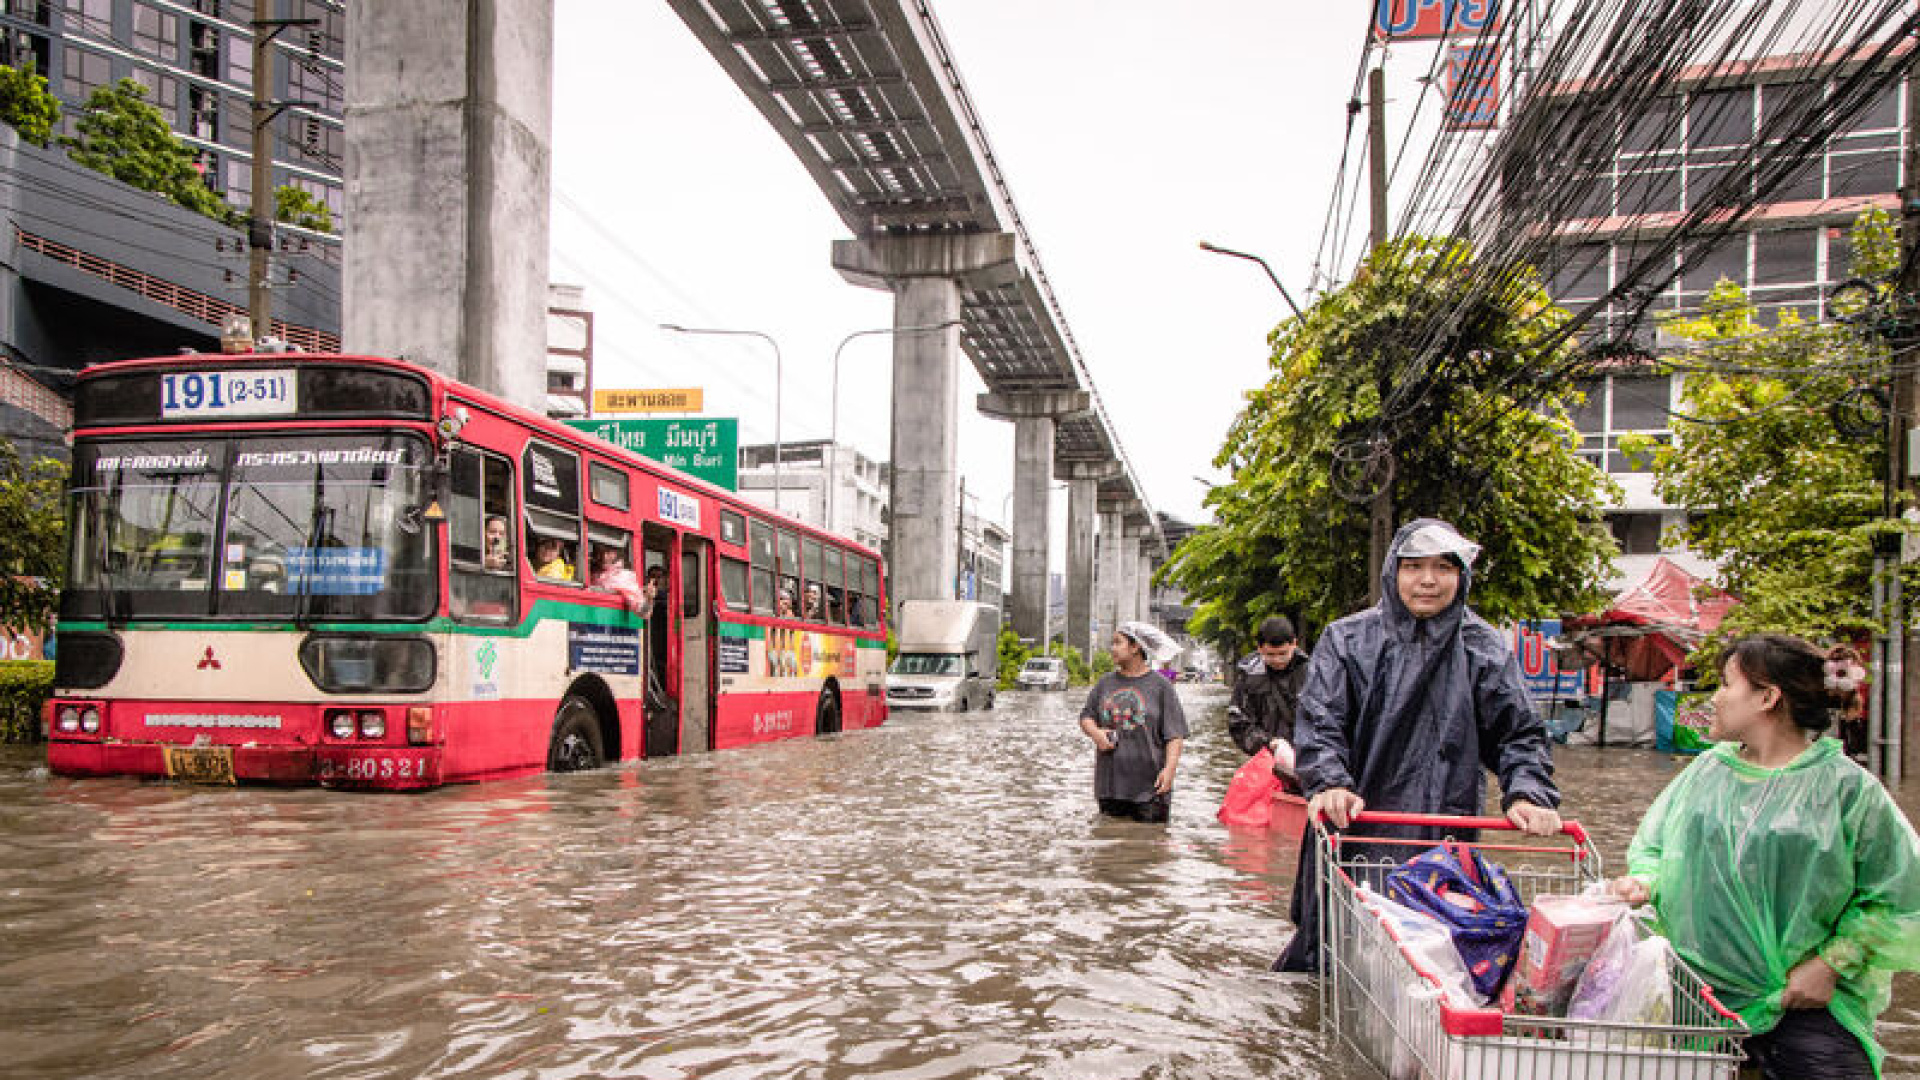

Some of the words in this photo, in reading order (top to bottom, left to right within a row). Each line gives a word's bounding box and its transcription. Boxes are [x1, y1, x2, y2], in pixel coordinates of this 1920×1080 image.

[164, 373, 226, 408] 191
[228, 377, 286, 403] (2-51)
[665, 421, 718, 453] มีนบุรี
[664, 453, 687, 467] Min
[693, 453, 723, 467] Buri
